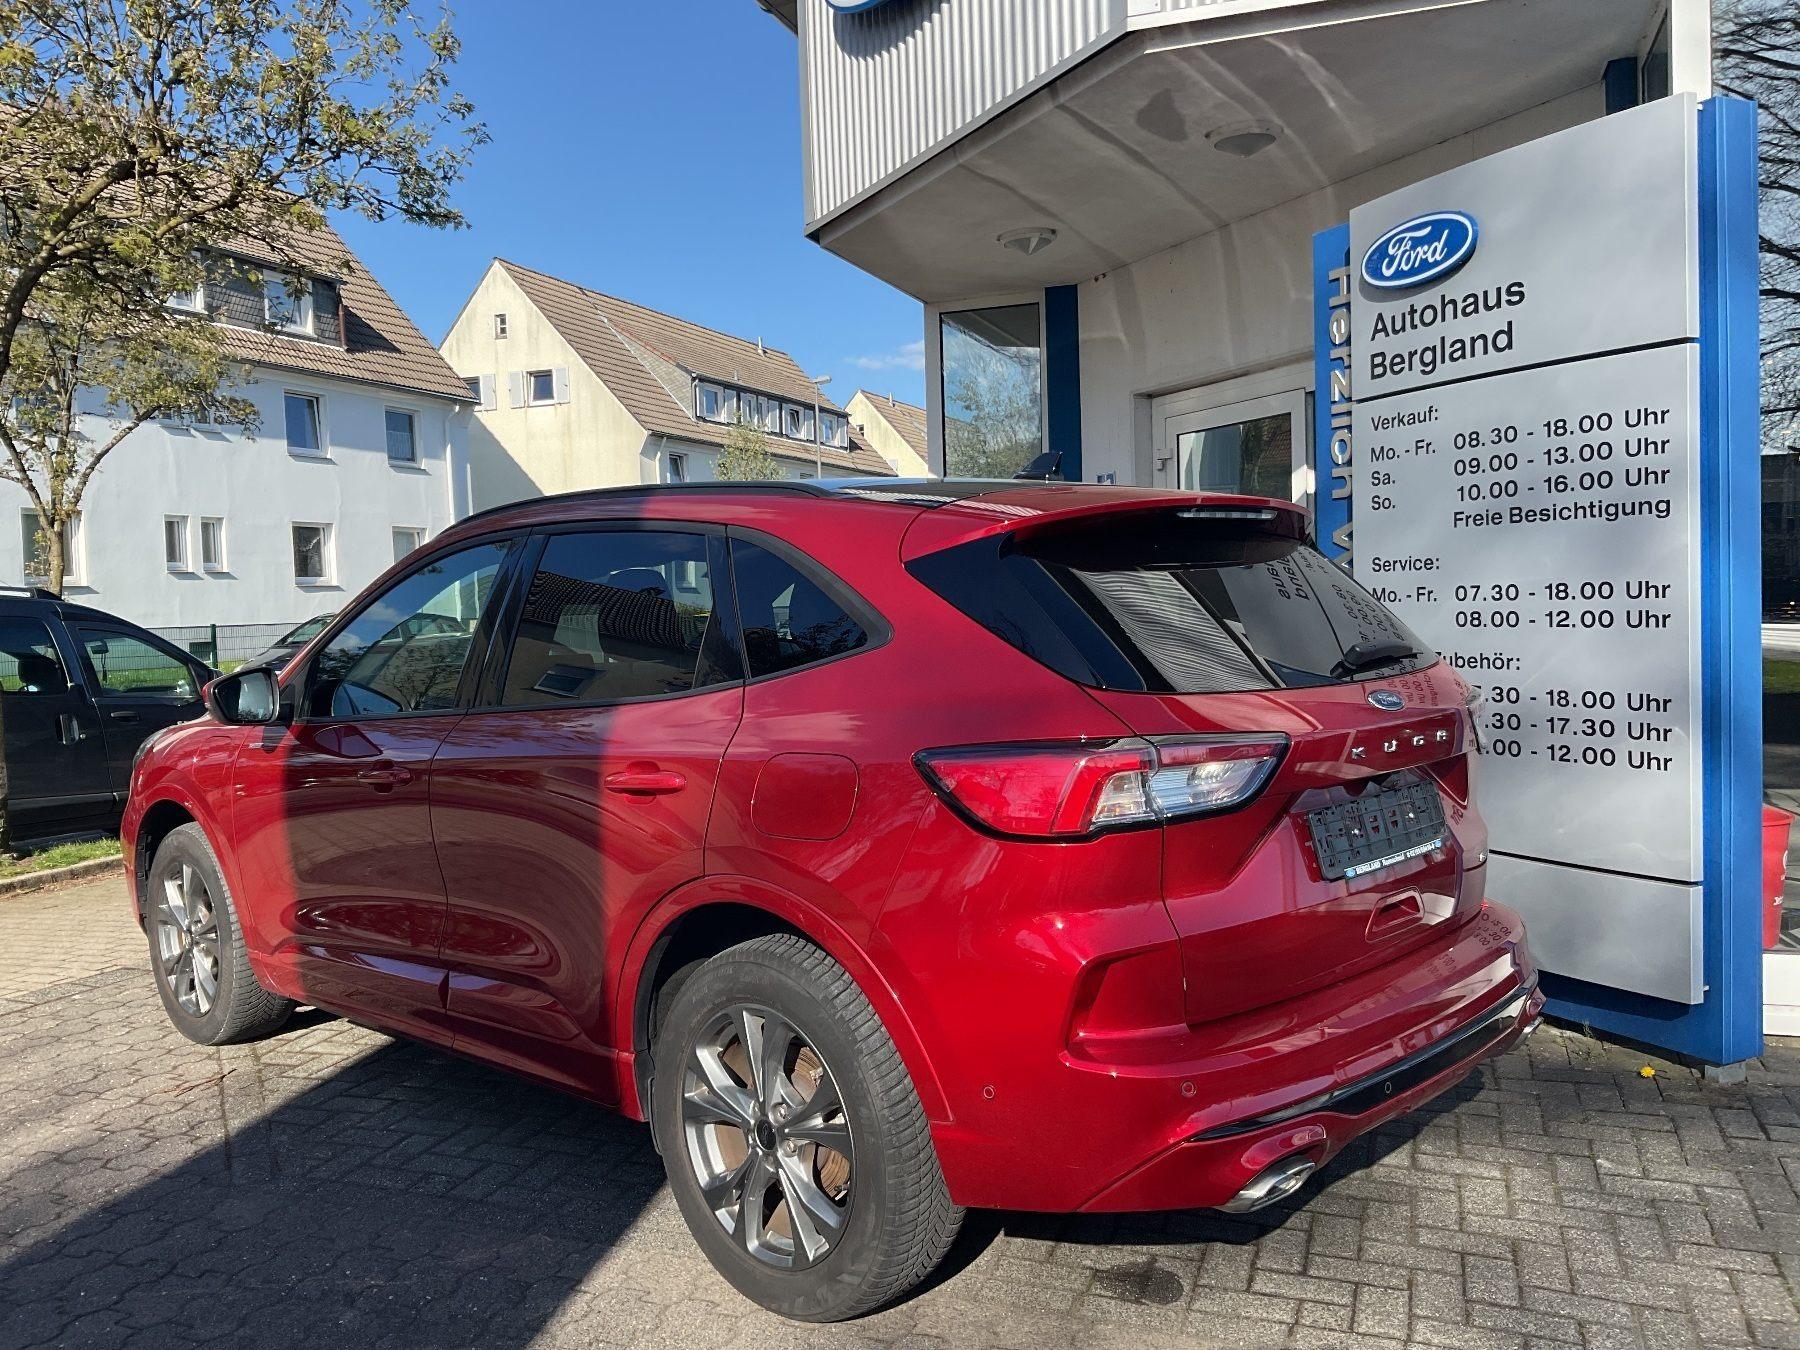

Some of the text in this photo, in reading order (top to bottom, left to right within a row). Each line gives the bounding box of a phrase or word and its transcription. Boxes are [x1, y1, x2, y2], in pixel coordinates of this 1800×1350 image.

[1370, 281, 1526, 341] Autohaus
[1370, 320, 1514, 380] Bergland
[1371, 405, 1439, 431] Verkauf:
[1453, 426, 1518, 450] 08.30
[1542, 412, 1613, 438] 18.00
[1624, 407, 1670, 429] Uhr
[1371, 472, 1396, 487] Sa.
[1453, 453, 1518, 476] 09.00
[1542, 441, 1614, 467] 13.00
[1624, 437, 1671, 457] Uhr
[1371, 496, 1396, 511] So.
[1456, 480, 1519, 502] 10.00
[1543, 470, 1614, 494] 16.00
[1624, 467, 1671, 487] Uhr
[1453, 499, 1671, 529] Freie Besichtigung
[1372, 557, 1440, 573] Service:
[1454, 584, 1520, 602] 07.30
[1544, 582, 1615, 601] 18.00
[1625, 580, 1672, 600] Uhr
[1455, 610, 1520, 628] 08.00
[1544, 609, 1615, 629] 12.00
[1625, 609, 1672, 629] Uhr
[1435, 652, 1521, 671] ubehör:
[1472, 685, 1520, 704] .30
[1545, 688, 1616, 710] 18.00
[1626, 692, 1673, 713] Uhr
[1484, 712, 1522, 731] .30
[1545, 716, 1617, 738] 17.30
[1627, 721, 1673, 743] Uhr
[1485, 738, 1522, 758] .00
[1546, 744, 1617, 767] 12.00
[1627, 750, 1673, 772] Uhr
